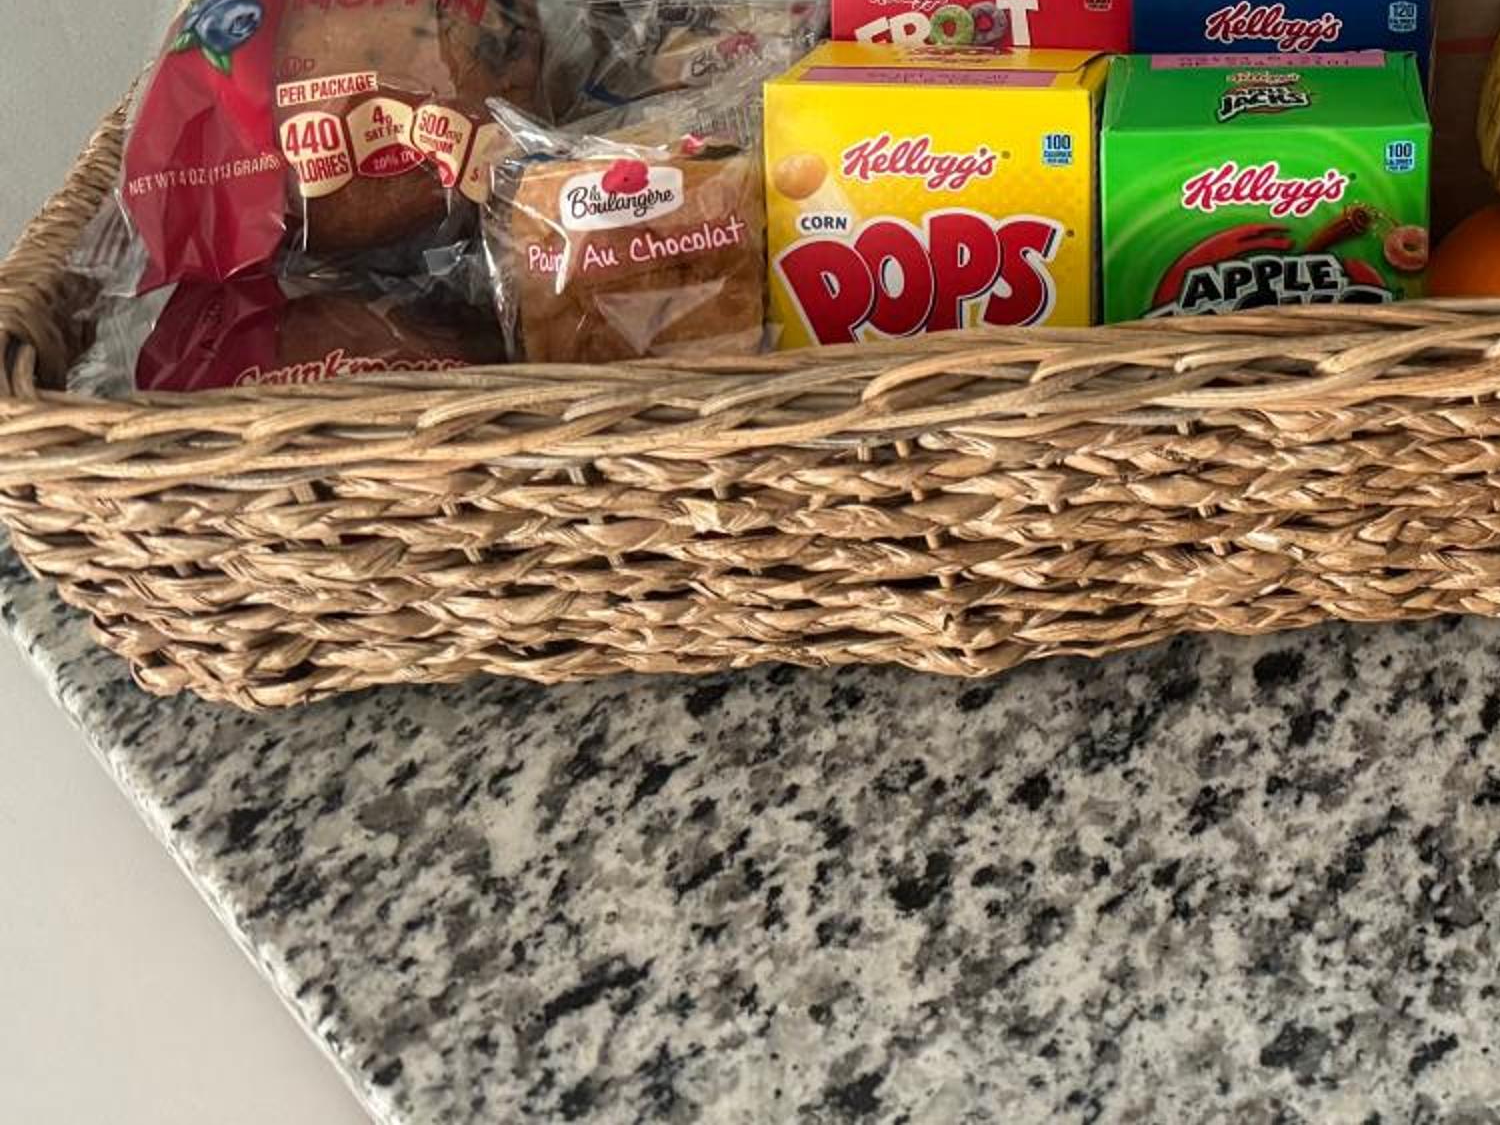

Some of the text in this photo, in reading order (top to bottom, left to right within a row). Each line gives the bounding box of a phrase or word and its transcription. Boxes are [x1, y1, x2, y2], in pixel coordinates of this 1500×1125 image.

[1205, 1, 1343, 51] Kellogg's
[279, 74, 376, 104] PER PACKAGE
[1217, 91, 1309, 121] JACKS
[286, 117, 341, 158] 440
[364, 127, 384, 143] SAT
[1046, 134, 1071, 150] 100
[1388, 142, 1413, 158] 100
[297, 151, 349, 183] LORIES
[842, 133, 998, 191] Kellogg's
[129, 174, 153, 196] NET
[155, 170, 176, 188] WT
[178, 169, 188, 186] 4
[188, 168, 207, 186] OZ
[1182, 161, 1347, 218] Kellogg's
[567, 186, 675, 218] Boulangère
[800, 215, 848, 231] CORN
[583, 244, 619, 272] Au
[629, 215, 745, 263] Chocolat
[778, 212, 1059, 346] POPS
[1181, 256, 1343, 310] APPLE
